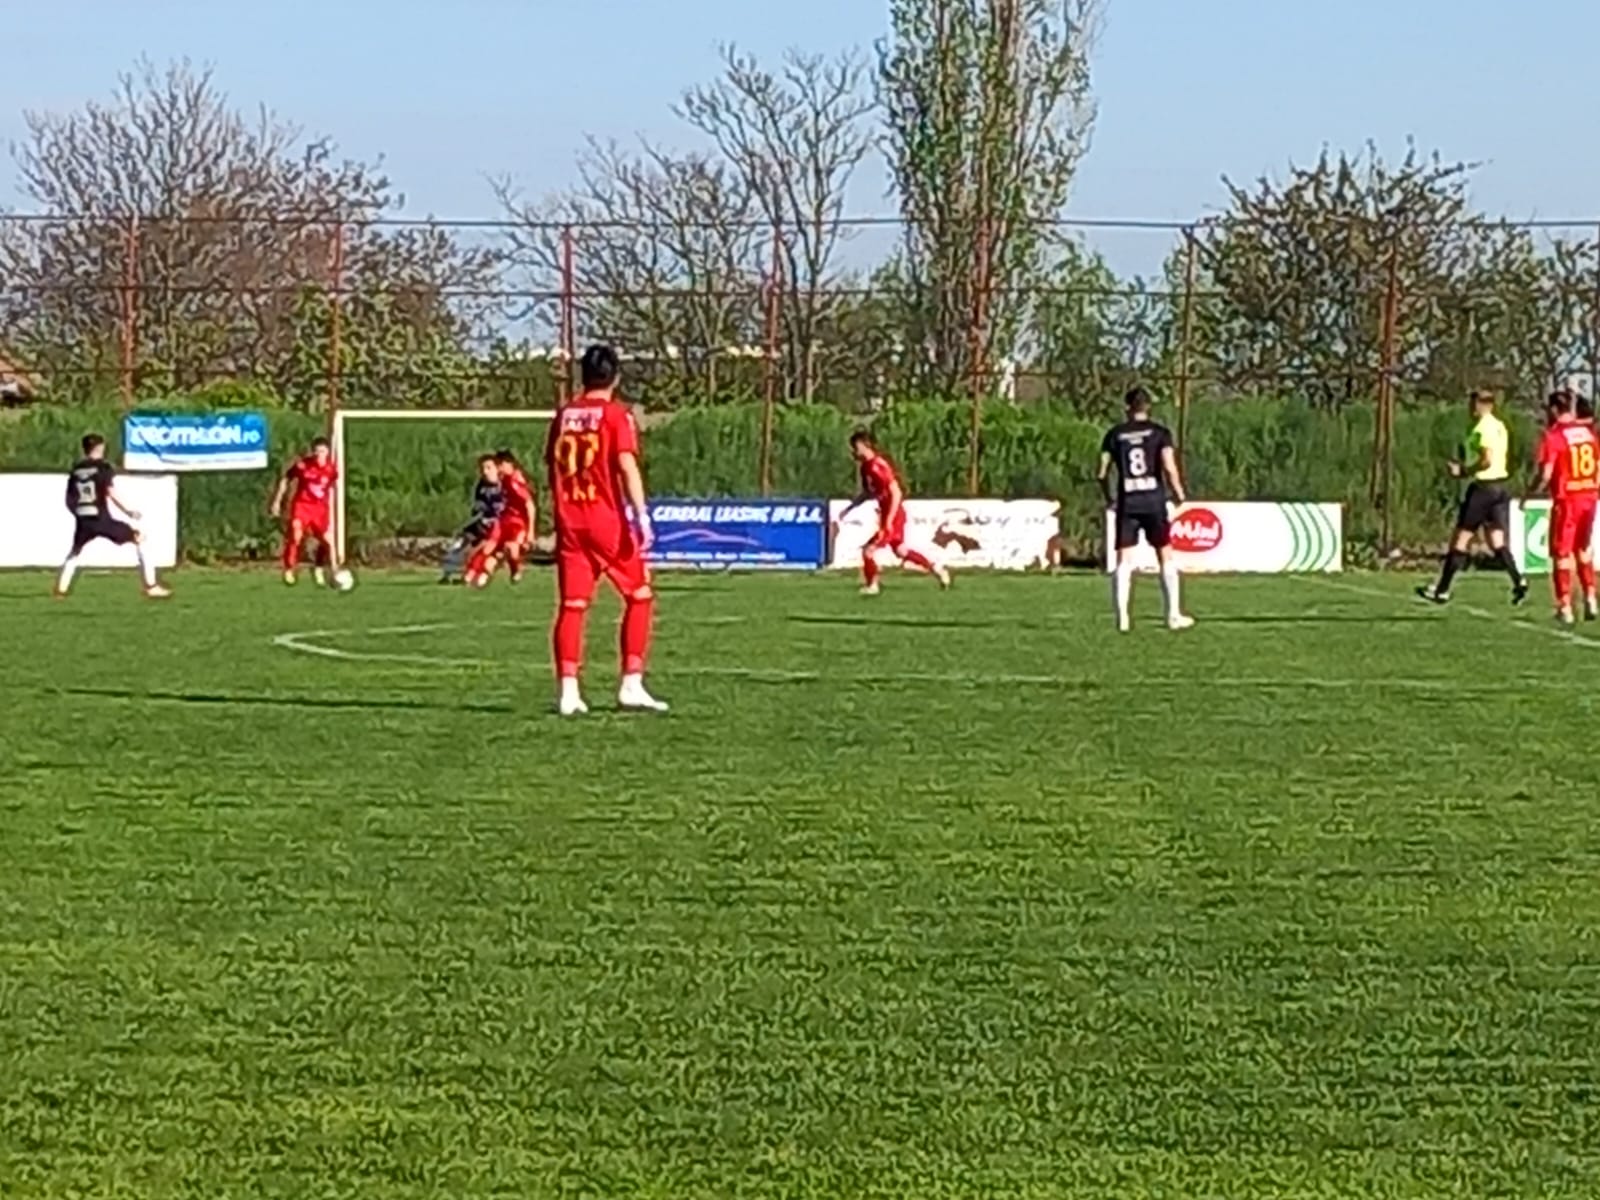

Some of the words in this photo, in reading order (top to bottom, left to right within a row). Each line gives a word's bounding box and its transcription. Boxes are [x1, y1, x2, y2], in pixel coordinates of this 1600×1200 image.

[1129, 447, 1147, 476] 8
[1570, 443, 1595, 478] 18
[714, 505, 771, 523] LEASING
